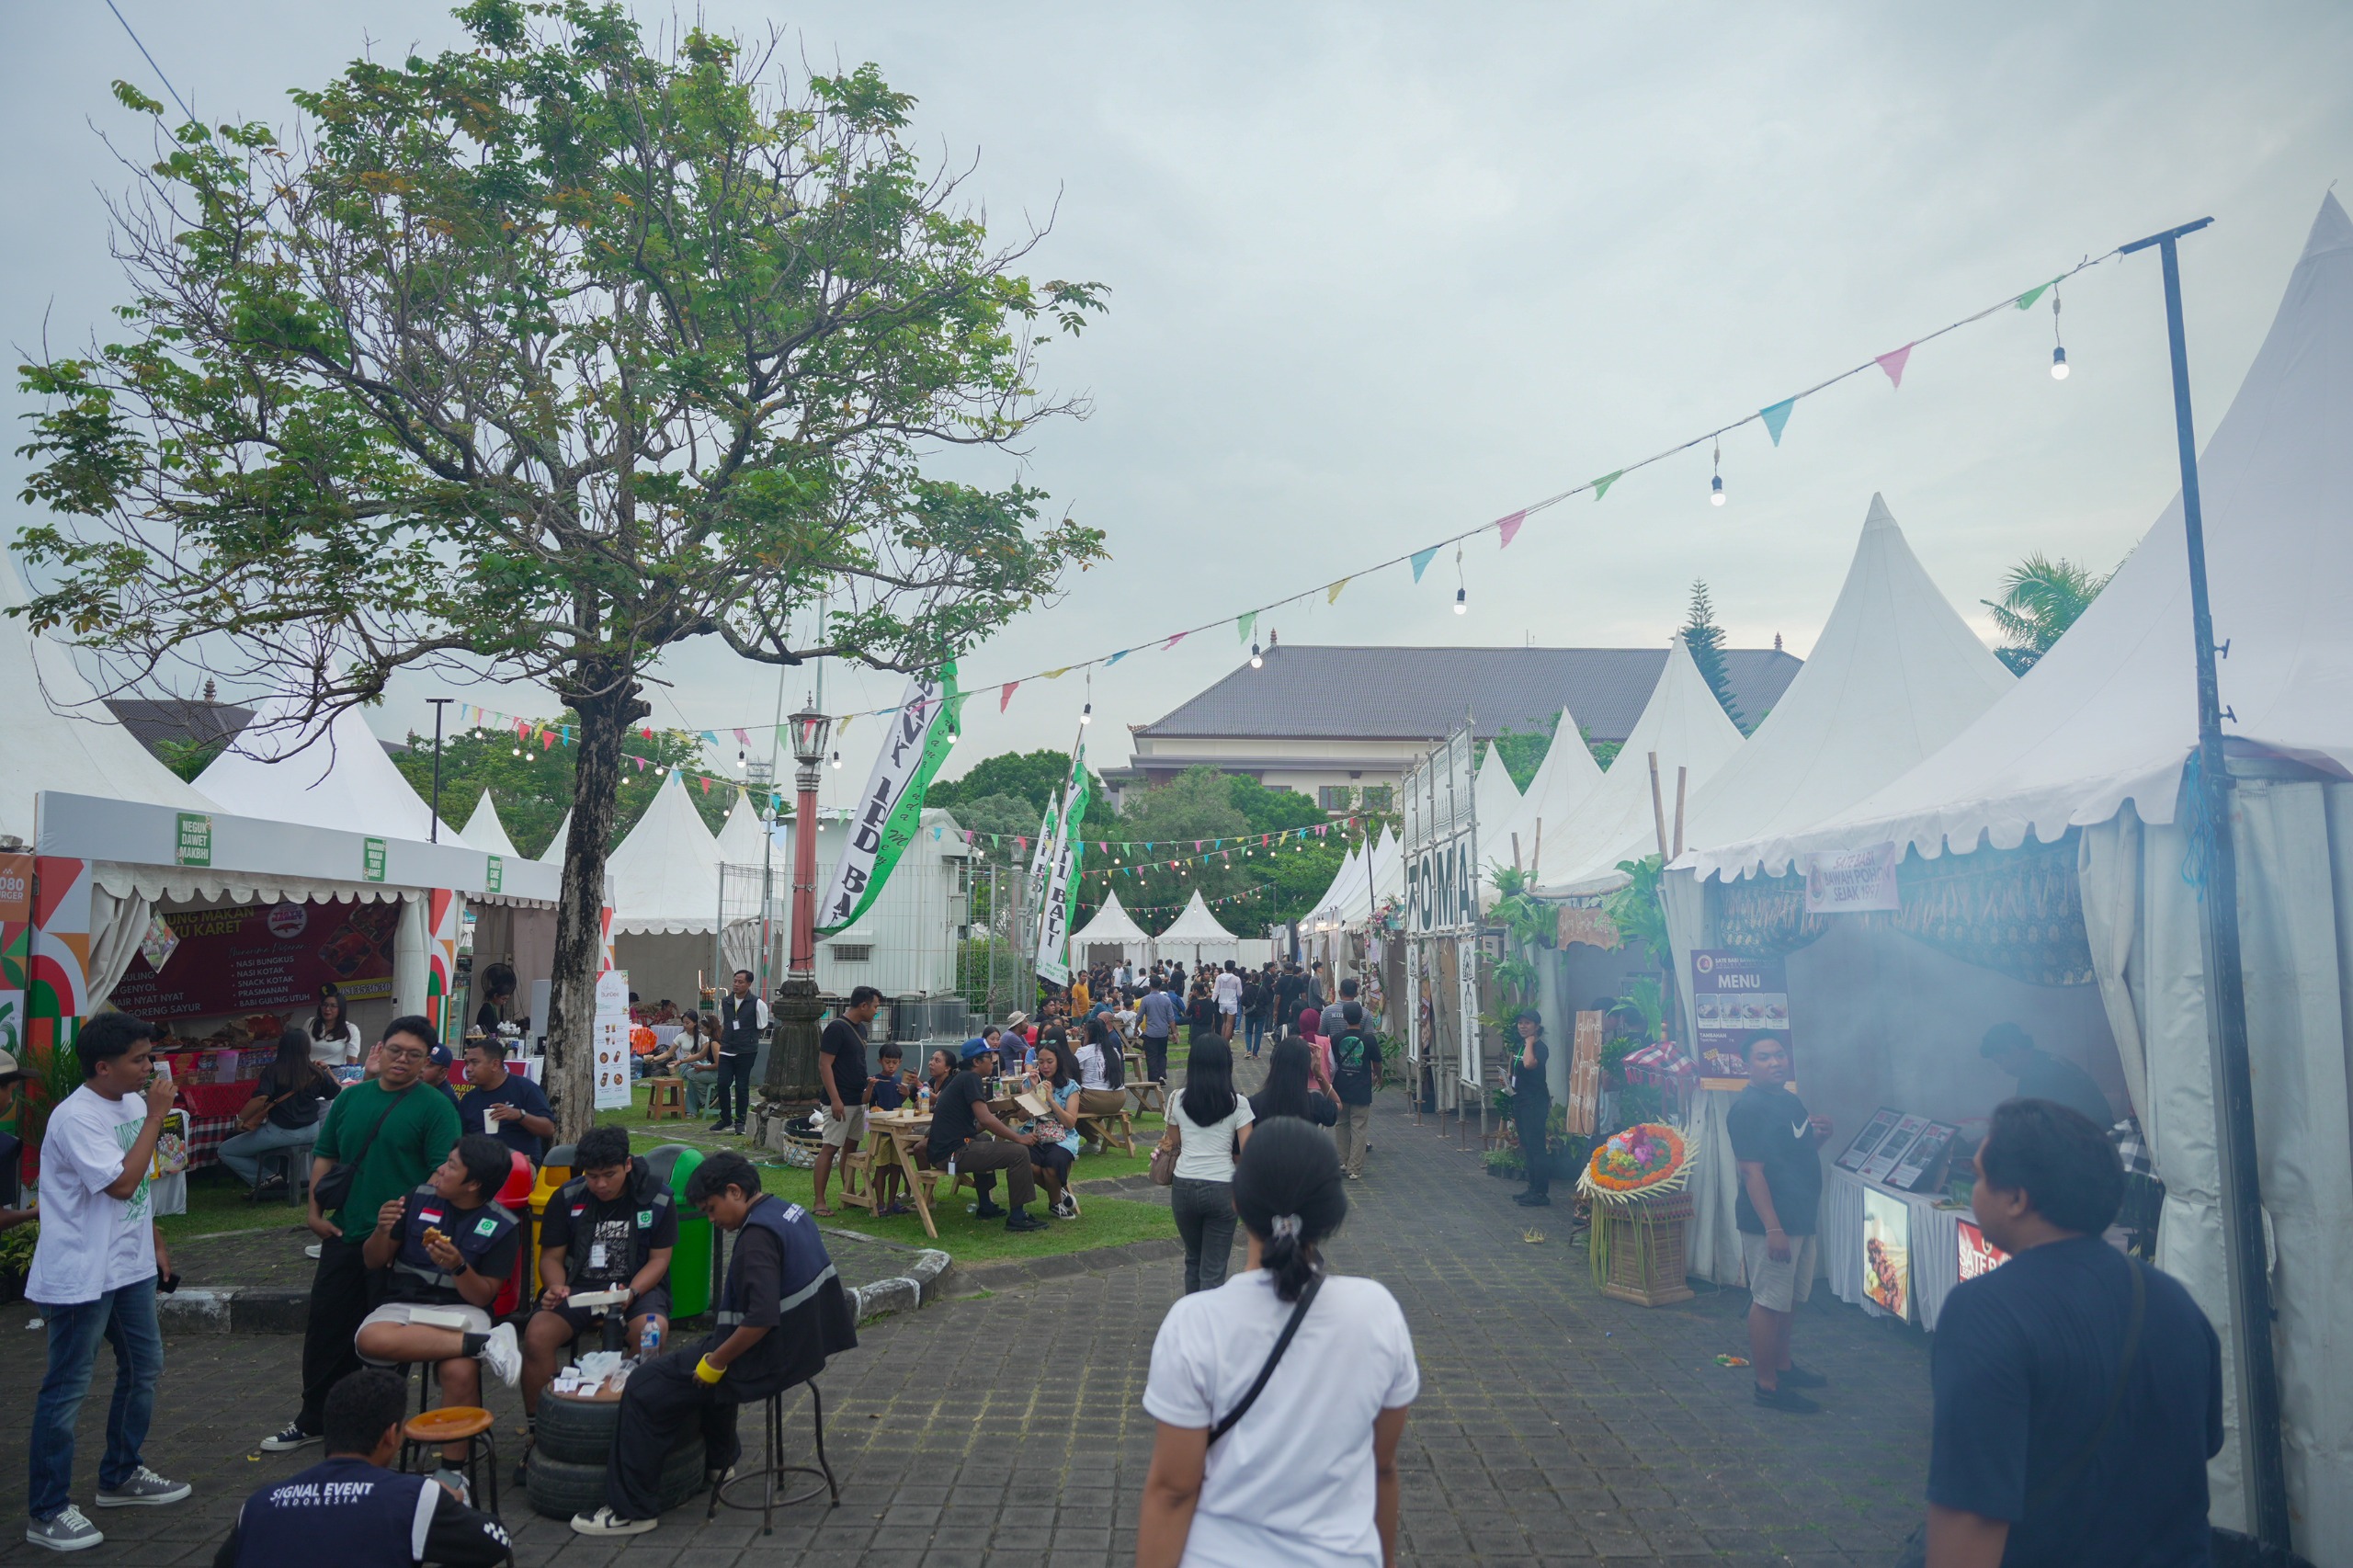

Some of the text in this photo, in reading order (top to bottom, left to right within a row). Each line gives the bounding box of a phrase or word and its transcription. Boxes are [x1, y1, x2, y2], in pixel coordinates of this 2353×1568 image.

[183, 820, 207, 834] NEGUK
[182, 833, 208, 846] DAWET
[179, 846, 209, 859] MAKBHI
[1824, 869, 1855, 886] BAWAH
[0, 891, 23, 900] RGER
[1834, 885, 1859, 902] SEJAK
[202, 906, 255, 922] MAKAN
[194, 920, 243, 937] KARET
[236, 956, 294, 968] NASI BUNGKUS
[236, 967, 284, 978] NASI KOTAK
[237, 976, 294, 988] SNACK KOTAK
[1718, 974, 1761, 988] MENU
[119, 983, 157, 994] GENYOL
[238, 986, 289, 997] PRASMANAN
[134, 995, 158, 1005] NYAT
[160, 993, 184, 1002] NYAT
[239, 994, 311, 1007] BABI GULING UTUH
[170, 1003, 201, 1014] SAYUR
[270, 1483, 374, 1501] SIGNAL EVENT
[275, 1495, 358, 1507] INDONESIA
